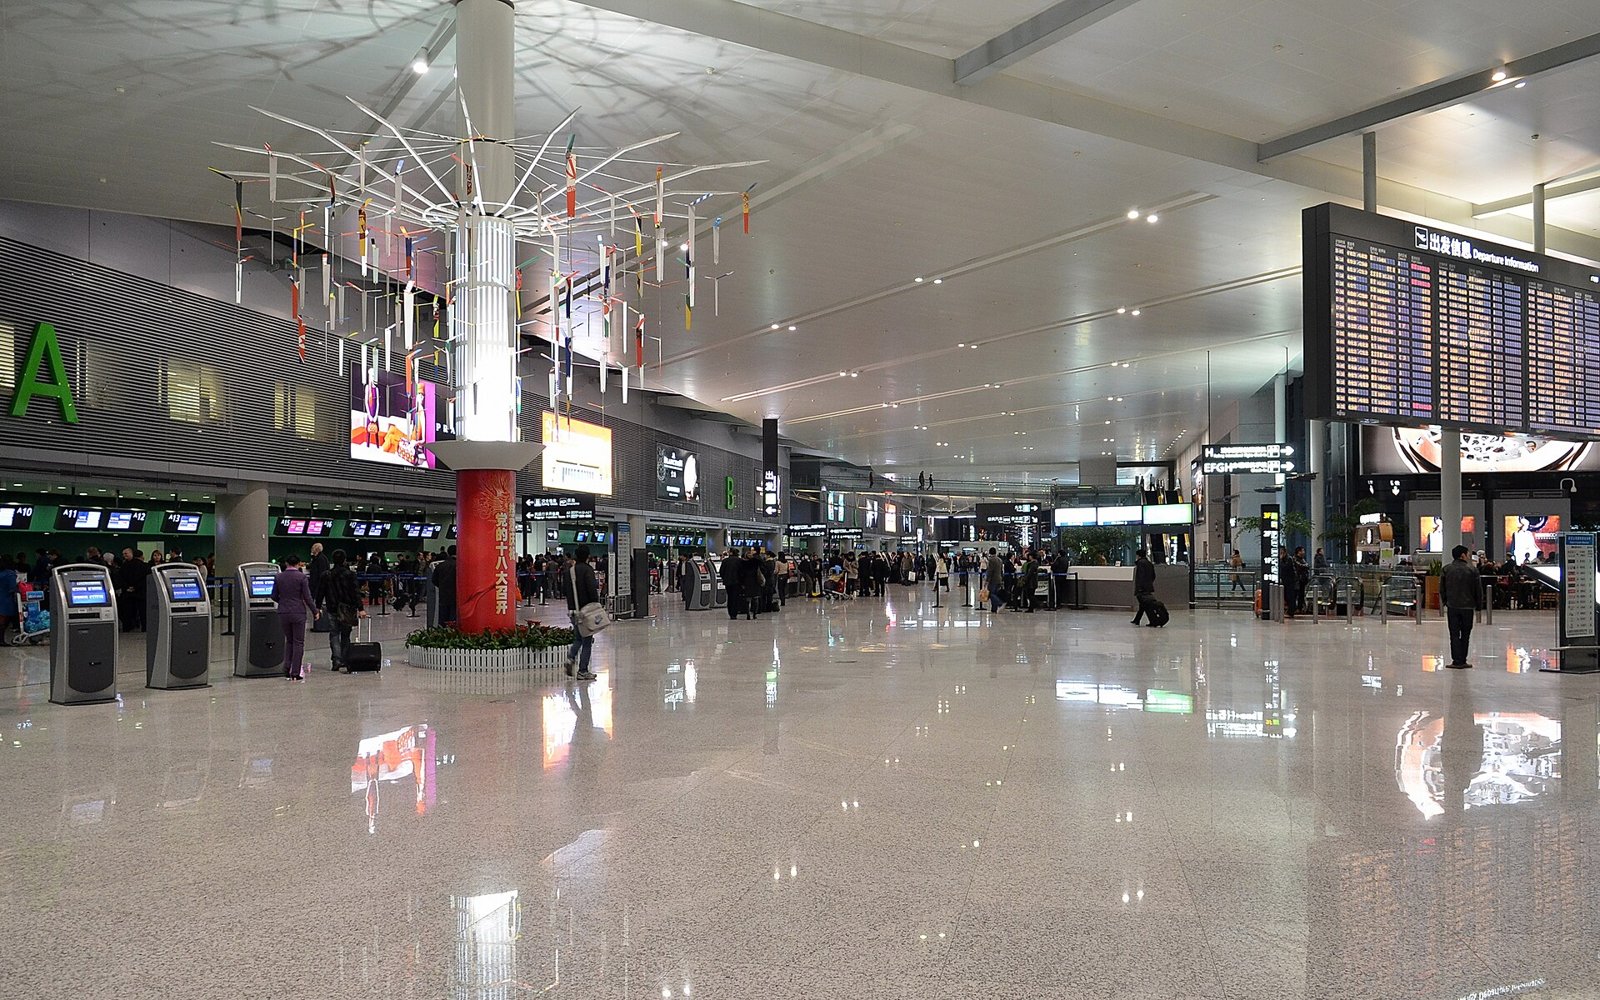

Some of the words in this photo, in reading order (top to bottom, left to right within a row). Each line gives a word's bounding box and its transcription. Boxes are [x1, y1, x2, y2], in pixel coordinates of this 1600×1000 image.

[1430, 233, 1472, 259] 出发信息
[1473, 249, 1504, 266] Departure
[1504, 257, 1539, 273] Information
[9, 322, 79, 424] A
[1205, 447, 1214, 458] H
[1204, 462, 1233, 473] EFGH
[725, 476, 735, 510] B
[16, 507, 33, 517] A10
[63, 509, 77, 518] A11
[133, 512, 146, 521] A12
[168, 514, 181, 523] A13
[495, 512, 508, 615] 党的十八大召开
